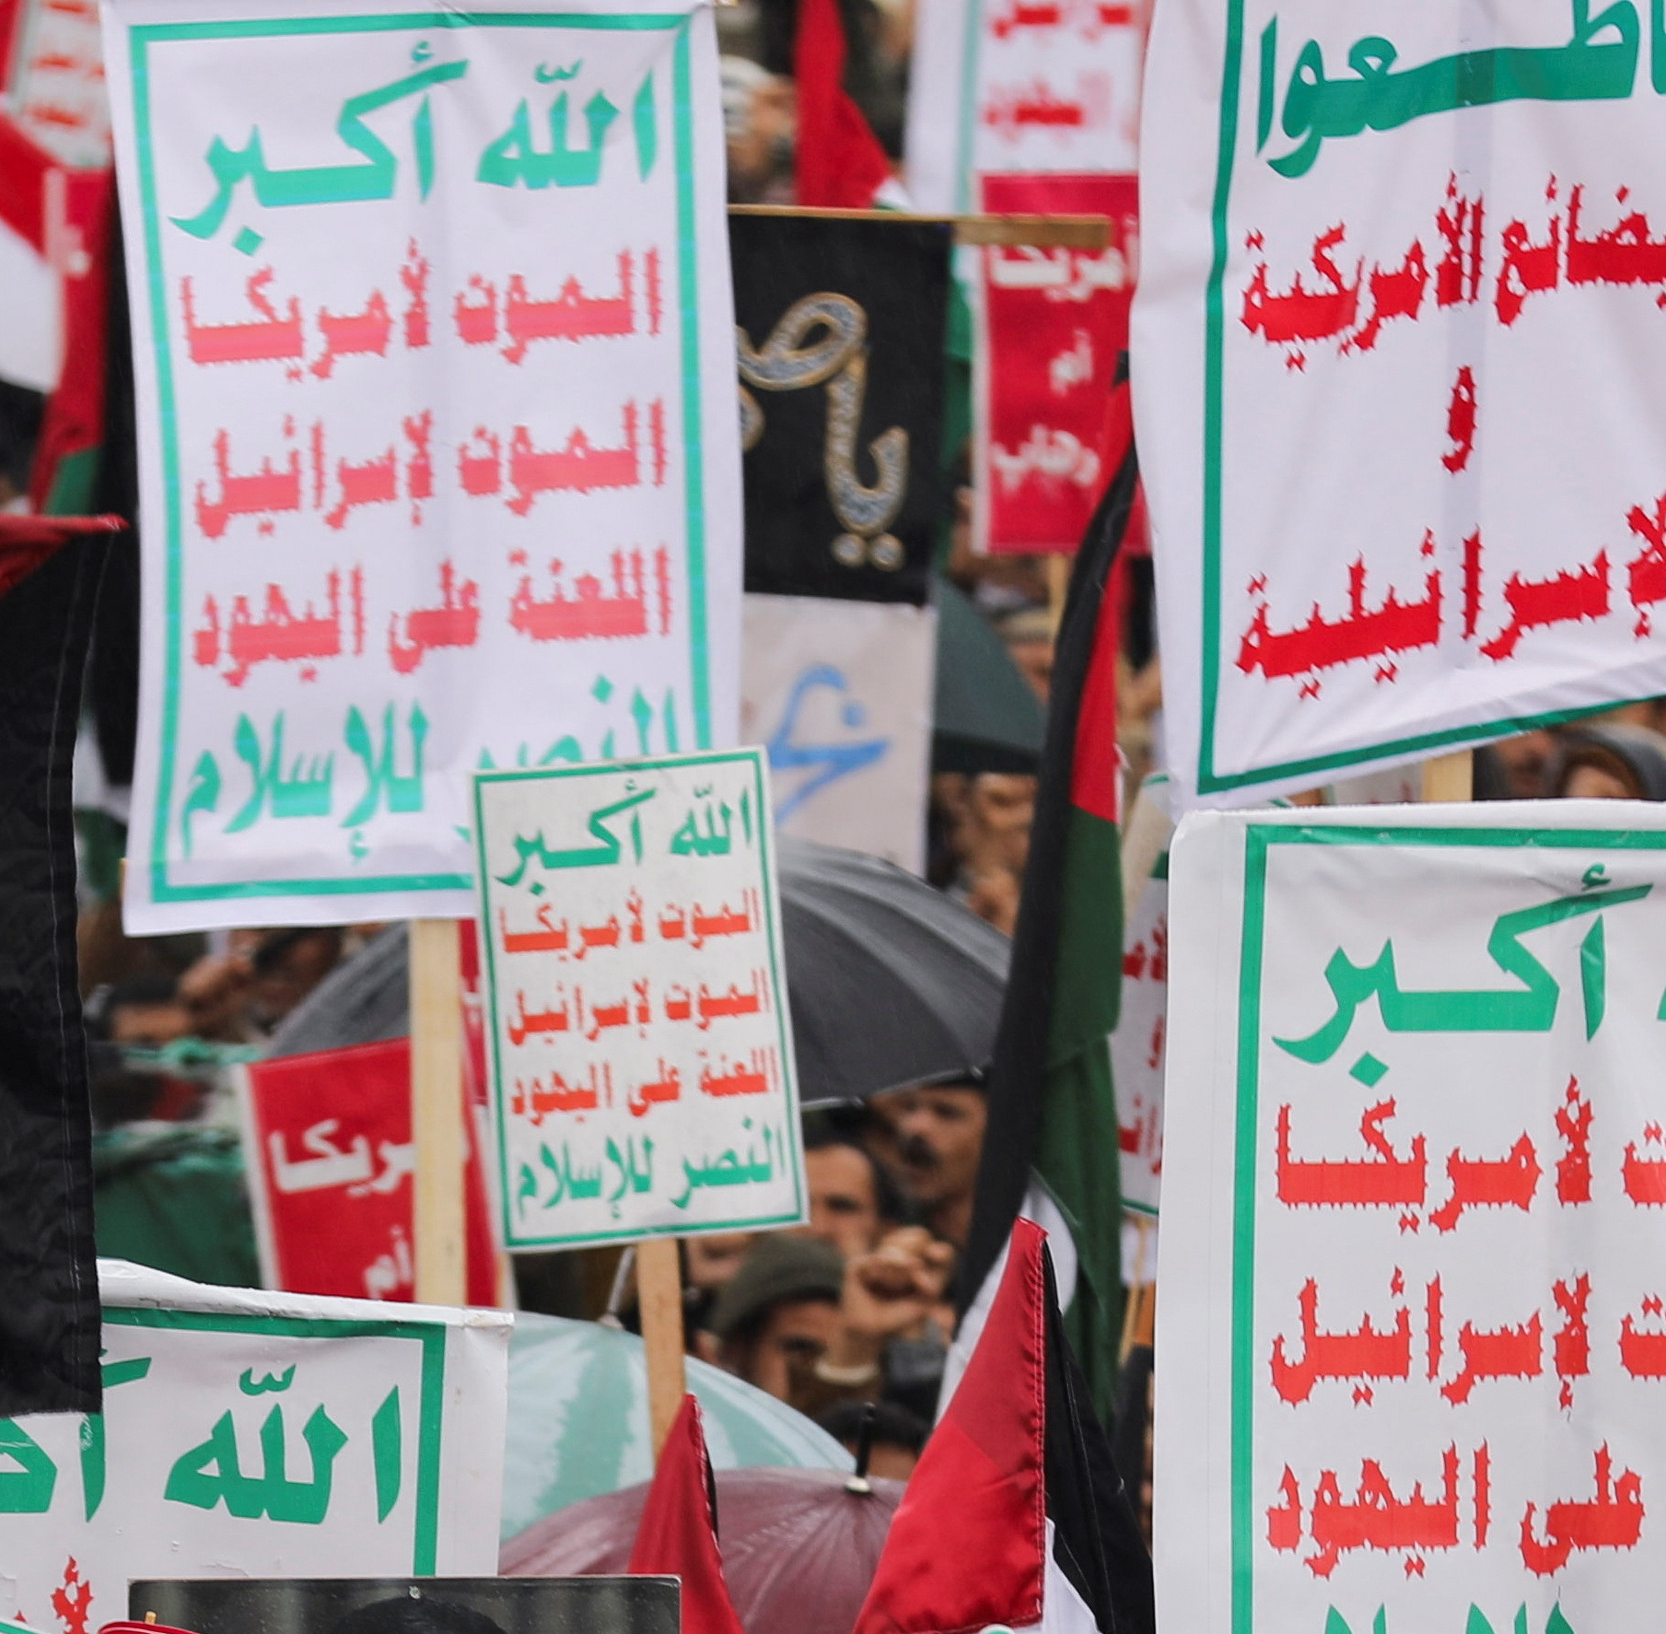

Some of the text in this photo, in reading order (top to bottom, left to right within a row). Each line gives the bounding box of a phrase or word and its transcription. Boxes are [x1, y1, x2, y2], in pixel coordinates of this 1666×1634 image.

[172, 42, 470, 255] أكبر
[183, 236, 661, 379] الموت لأمريكا
[1240, 175, 1485, 369] الأمريكية
[196, 412, 433, 538] لإسرائيل
[459, 402, 666, 515] الموت
[1442, 366, 1477, 473] و
[194, 549, 670, 687] اللعنة على اليهود
[181, 705, 429, 858] للإسلام
[497, 785, 656, 895] أكبر
[501, 886, 760, 961] الموت لأمريكا
[1273, 864, 1652, 1087] أكبر
[507, 968, 769, 1046] الموت لإسرائيل
[512, 1046, 779, 1126] اللعنة على اليهود
[518, 1113, 791, 1218] النصر للإسلام
[1276, 1077, 1594, 1232] لأمريكا
[1269, 1269, 1592, 1408] لإسرائيل
[1267, 1444, 1491, 1578] اليهود
[1519, 1440, 1645, 1576] على
